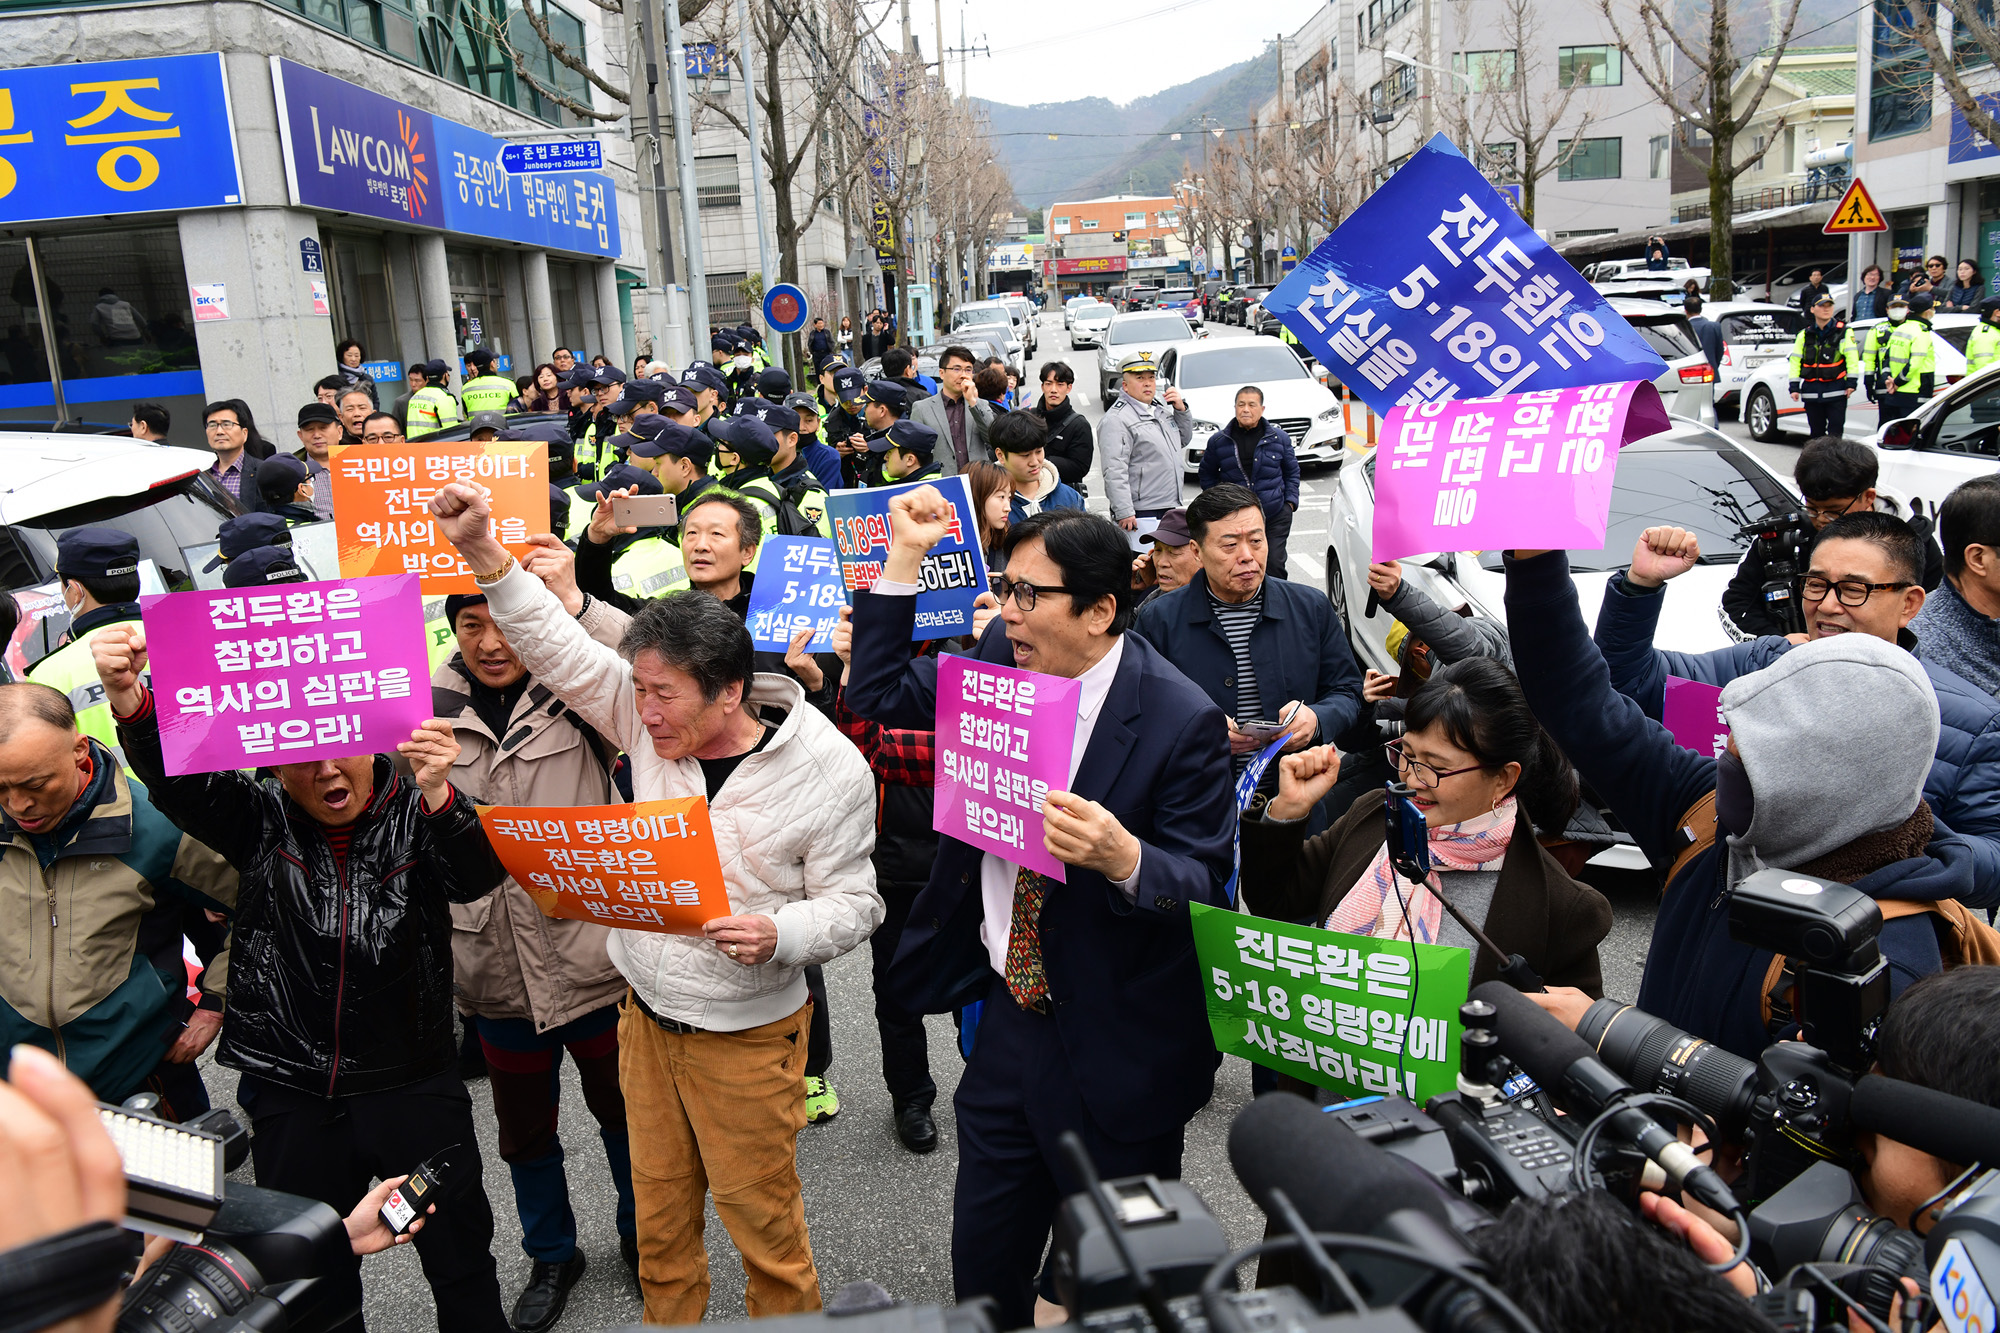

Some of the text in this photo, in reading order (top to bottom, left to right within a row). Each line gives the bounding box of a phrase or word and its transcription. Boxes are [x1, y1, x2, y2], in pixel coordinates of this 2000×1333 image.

[310, 105, 411, 180] LAWCOM
[524, 158, 600, 170] Junbeop-ro 25beon-gil
[390, 185, 408, 212] 로컴
[454, 151, 609, 250] 공증인가 법무법인 로컴
[306, 254, 317, 270] 25
[196, 296, 210, 304] SK
[1427, 193, 1604, 370] 전두환은
[470, 318, 481, 344] 증
[1296, 270, 1418, 391] 진실을
[467, 392, 501, 400] POLICE
[341, 454, 536, 483] 국민의 명령이다.
[1432, 411, 1496, 528] 심판을
[384, 486, 494, 516] 전두
[356, 520, 435, 548] 역사의
[834, 512, 894, 556] 5.18역
[110, 566, 136, 575] POLICE
[271, 570, 296, 579] POLICE
[208, 588, 362, 630] 전두환은
[754, 612, 816, 643] 진실을
[914, 609, 965, 628] 전라남도당
[214, 630, 367, 673] 참회하고
[175, 666, 412, 717] 역사의 심판을
[962, 668, 1036, 717] 전두환은
[236, 714, 364, 754] 받으라!
[958, 711, 1030, 763] 참회하고
[942, 748, 1050, 815] 역사의 심판을
[492, 812, 698, 844] 국민의 명령이다.
[964, 798, 1025, 850] 받으라!
[543, 848, 659, 876] 전두환은
[528, 872, 702, 906] 역사의 심판을
[582, 900, 666, 926] 받으라
[1234, 925, 1412, 1000] 전두환은
[1212, 966, 1449, 1063] 5·18 영령앞에
[1242, 1018, 1417, 1106] 사죄하라!
